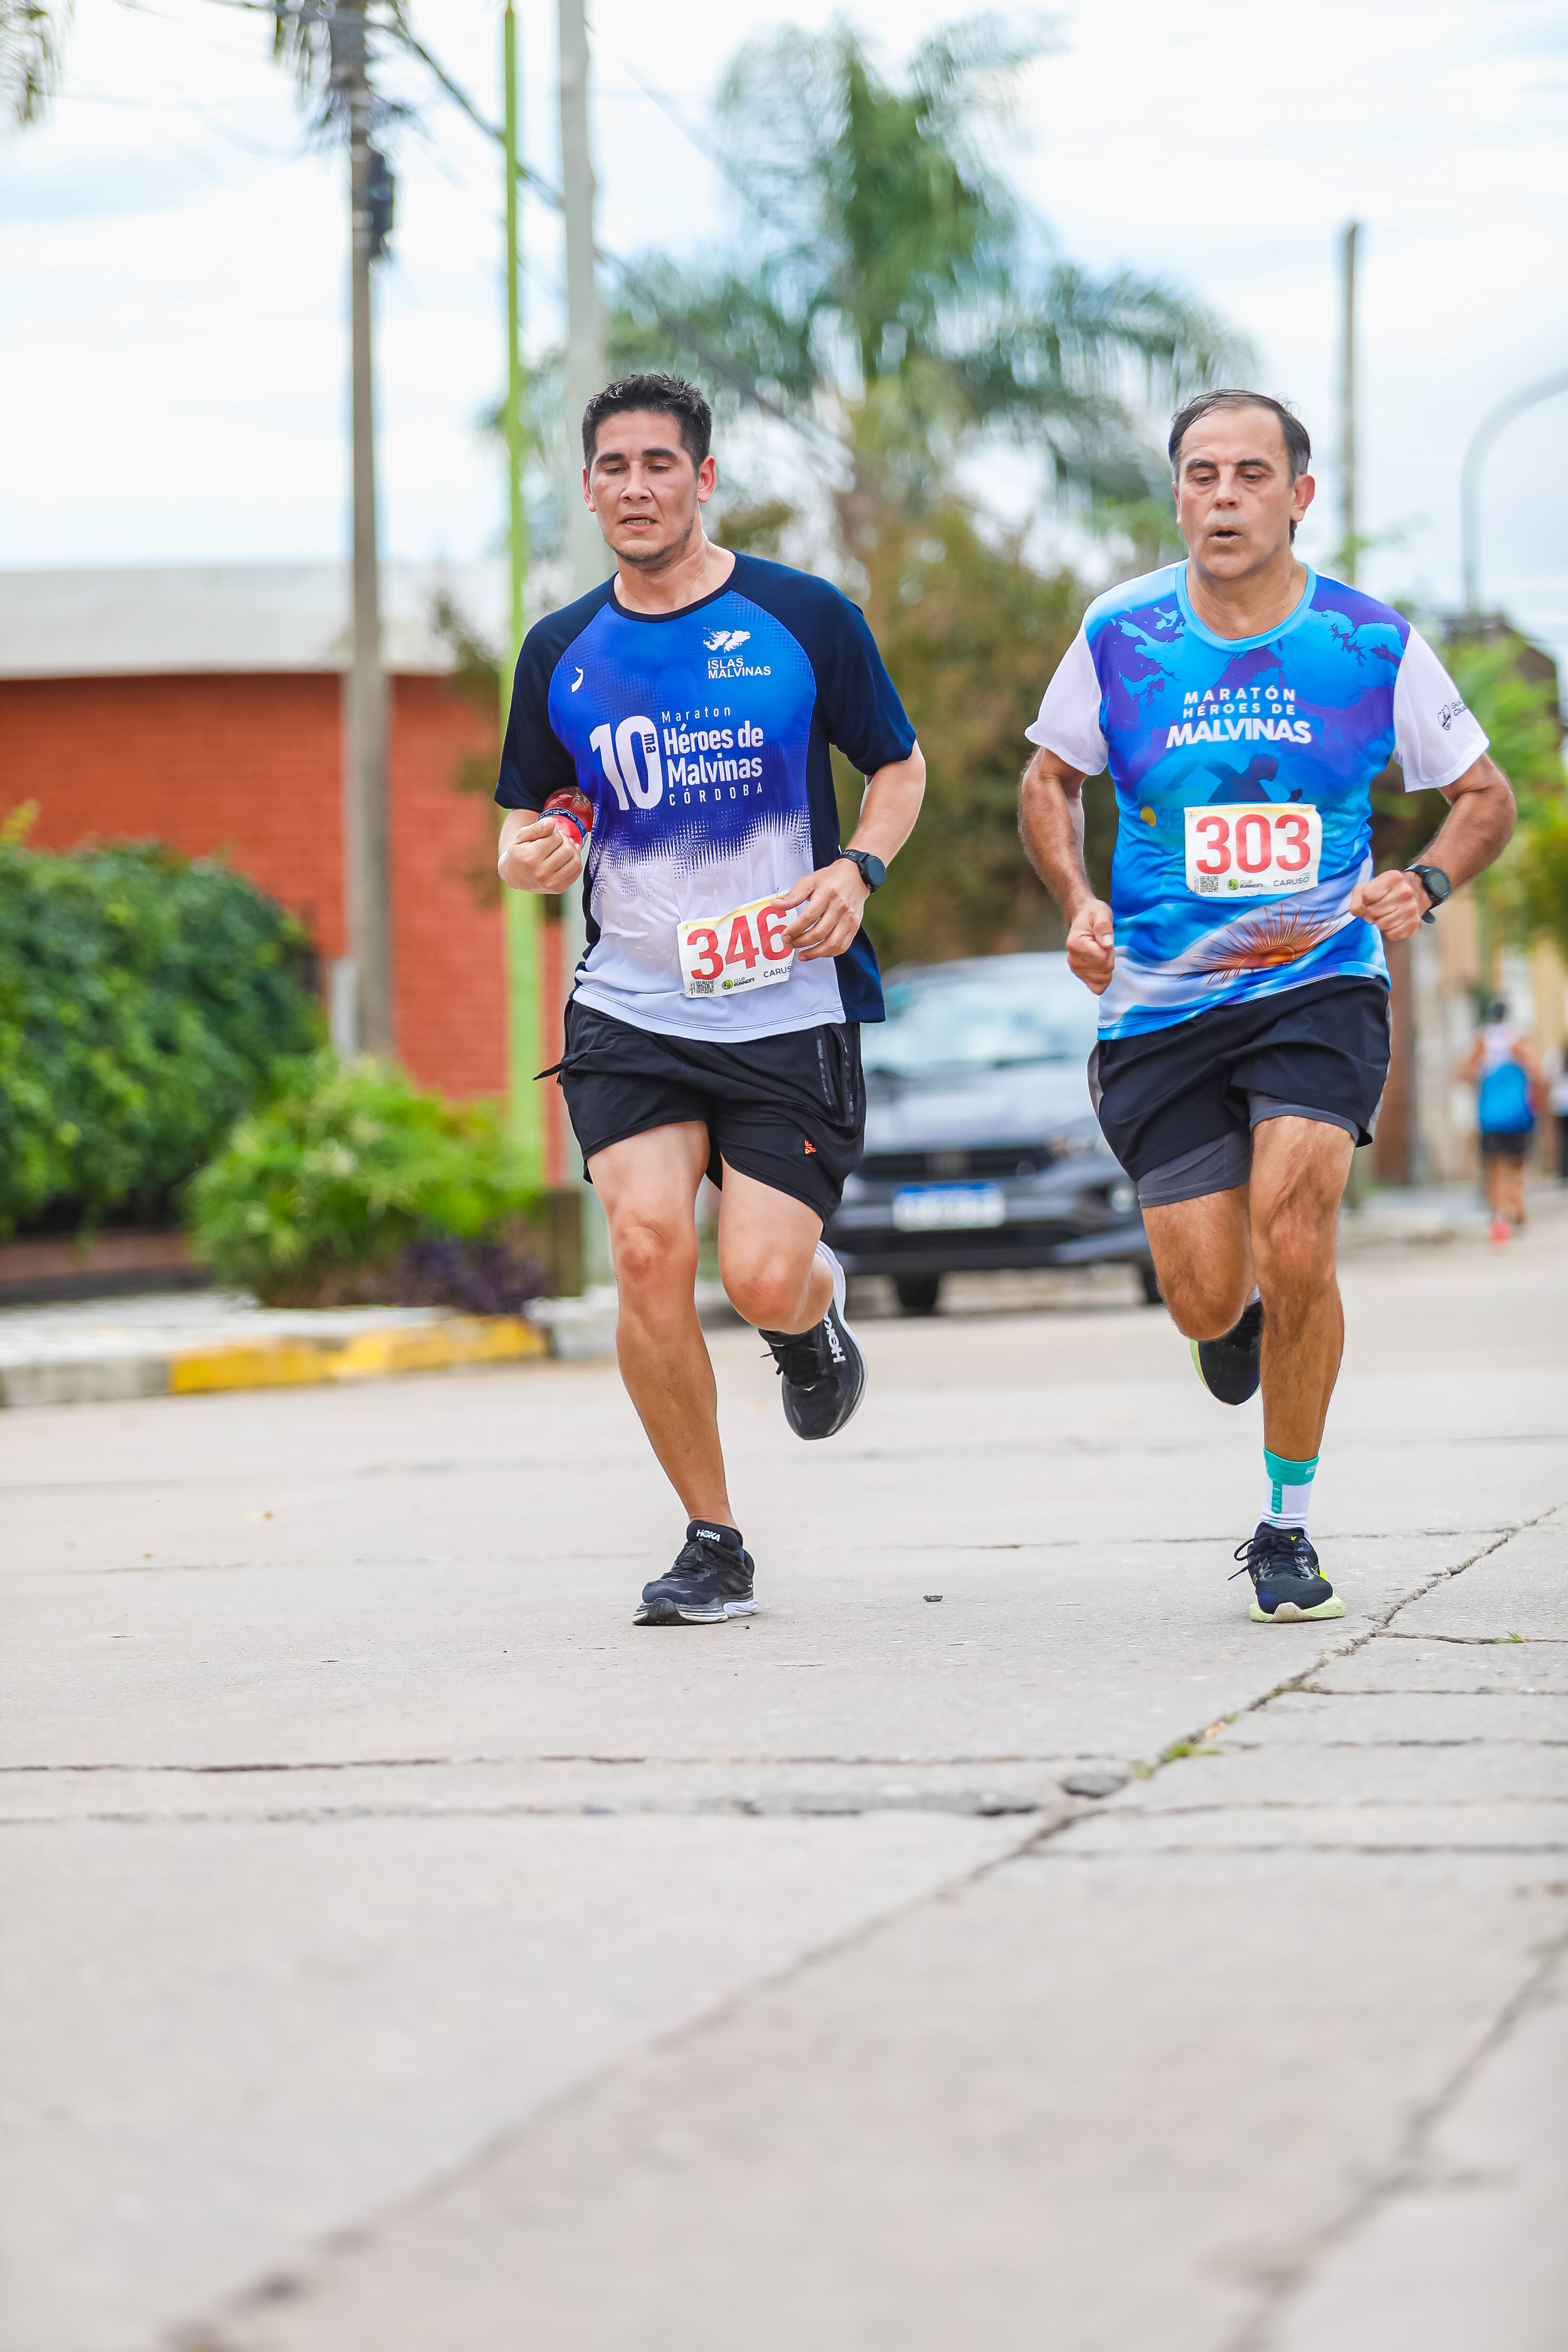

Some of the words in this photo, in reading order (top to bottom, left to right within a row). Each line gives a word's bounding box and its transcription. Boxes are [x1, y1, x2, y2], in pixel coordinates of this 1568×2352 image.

[708, 658, 743, 670] ISLAS
[708, 665, 771, 679] MALVINAS
[1184, 685, 1296, 705] MARATÓN
[662, 707, 731, 723] Maraton
[1183, 703, 1260, 719] HÉROES
[1271, 703, 1296, 715] DE
[663, 723, 734, 756] Héroes
[737, 720, 764, 748] de
[1165, 718, 1312, 749] MALVINAS
[590, 715, 663, 810] 10
[667, 753, 763, 788] Malvinas
[669, 782, 763, 806] CÓRDOBA
[1195, 814, 1311, 874] 303
[1273, 876, 1310, 887] CARUSO
[687, 905, 793, 981] 346
[696, 1529, 721, 1542] HOKA
